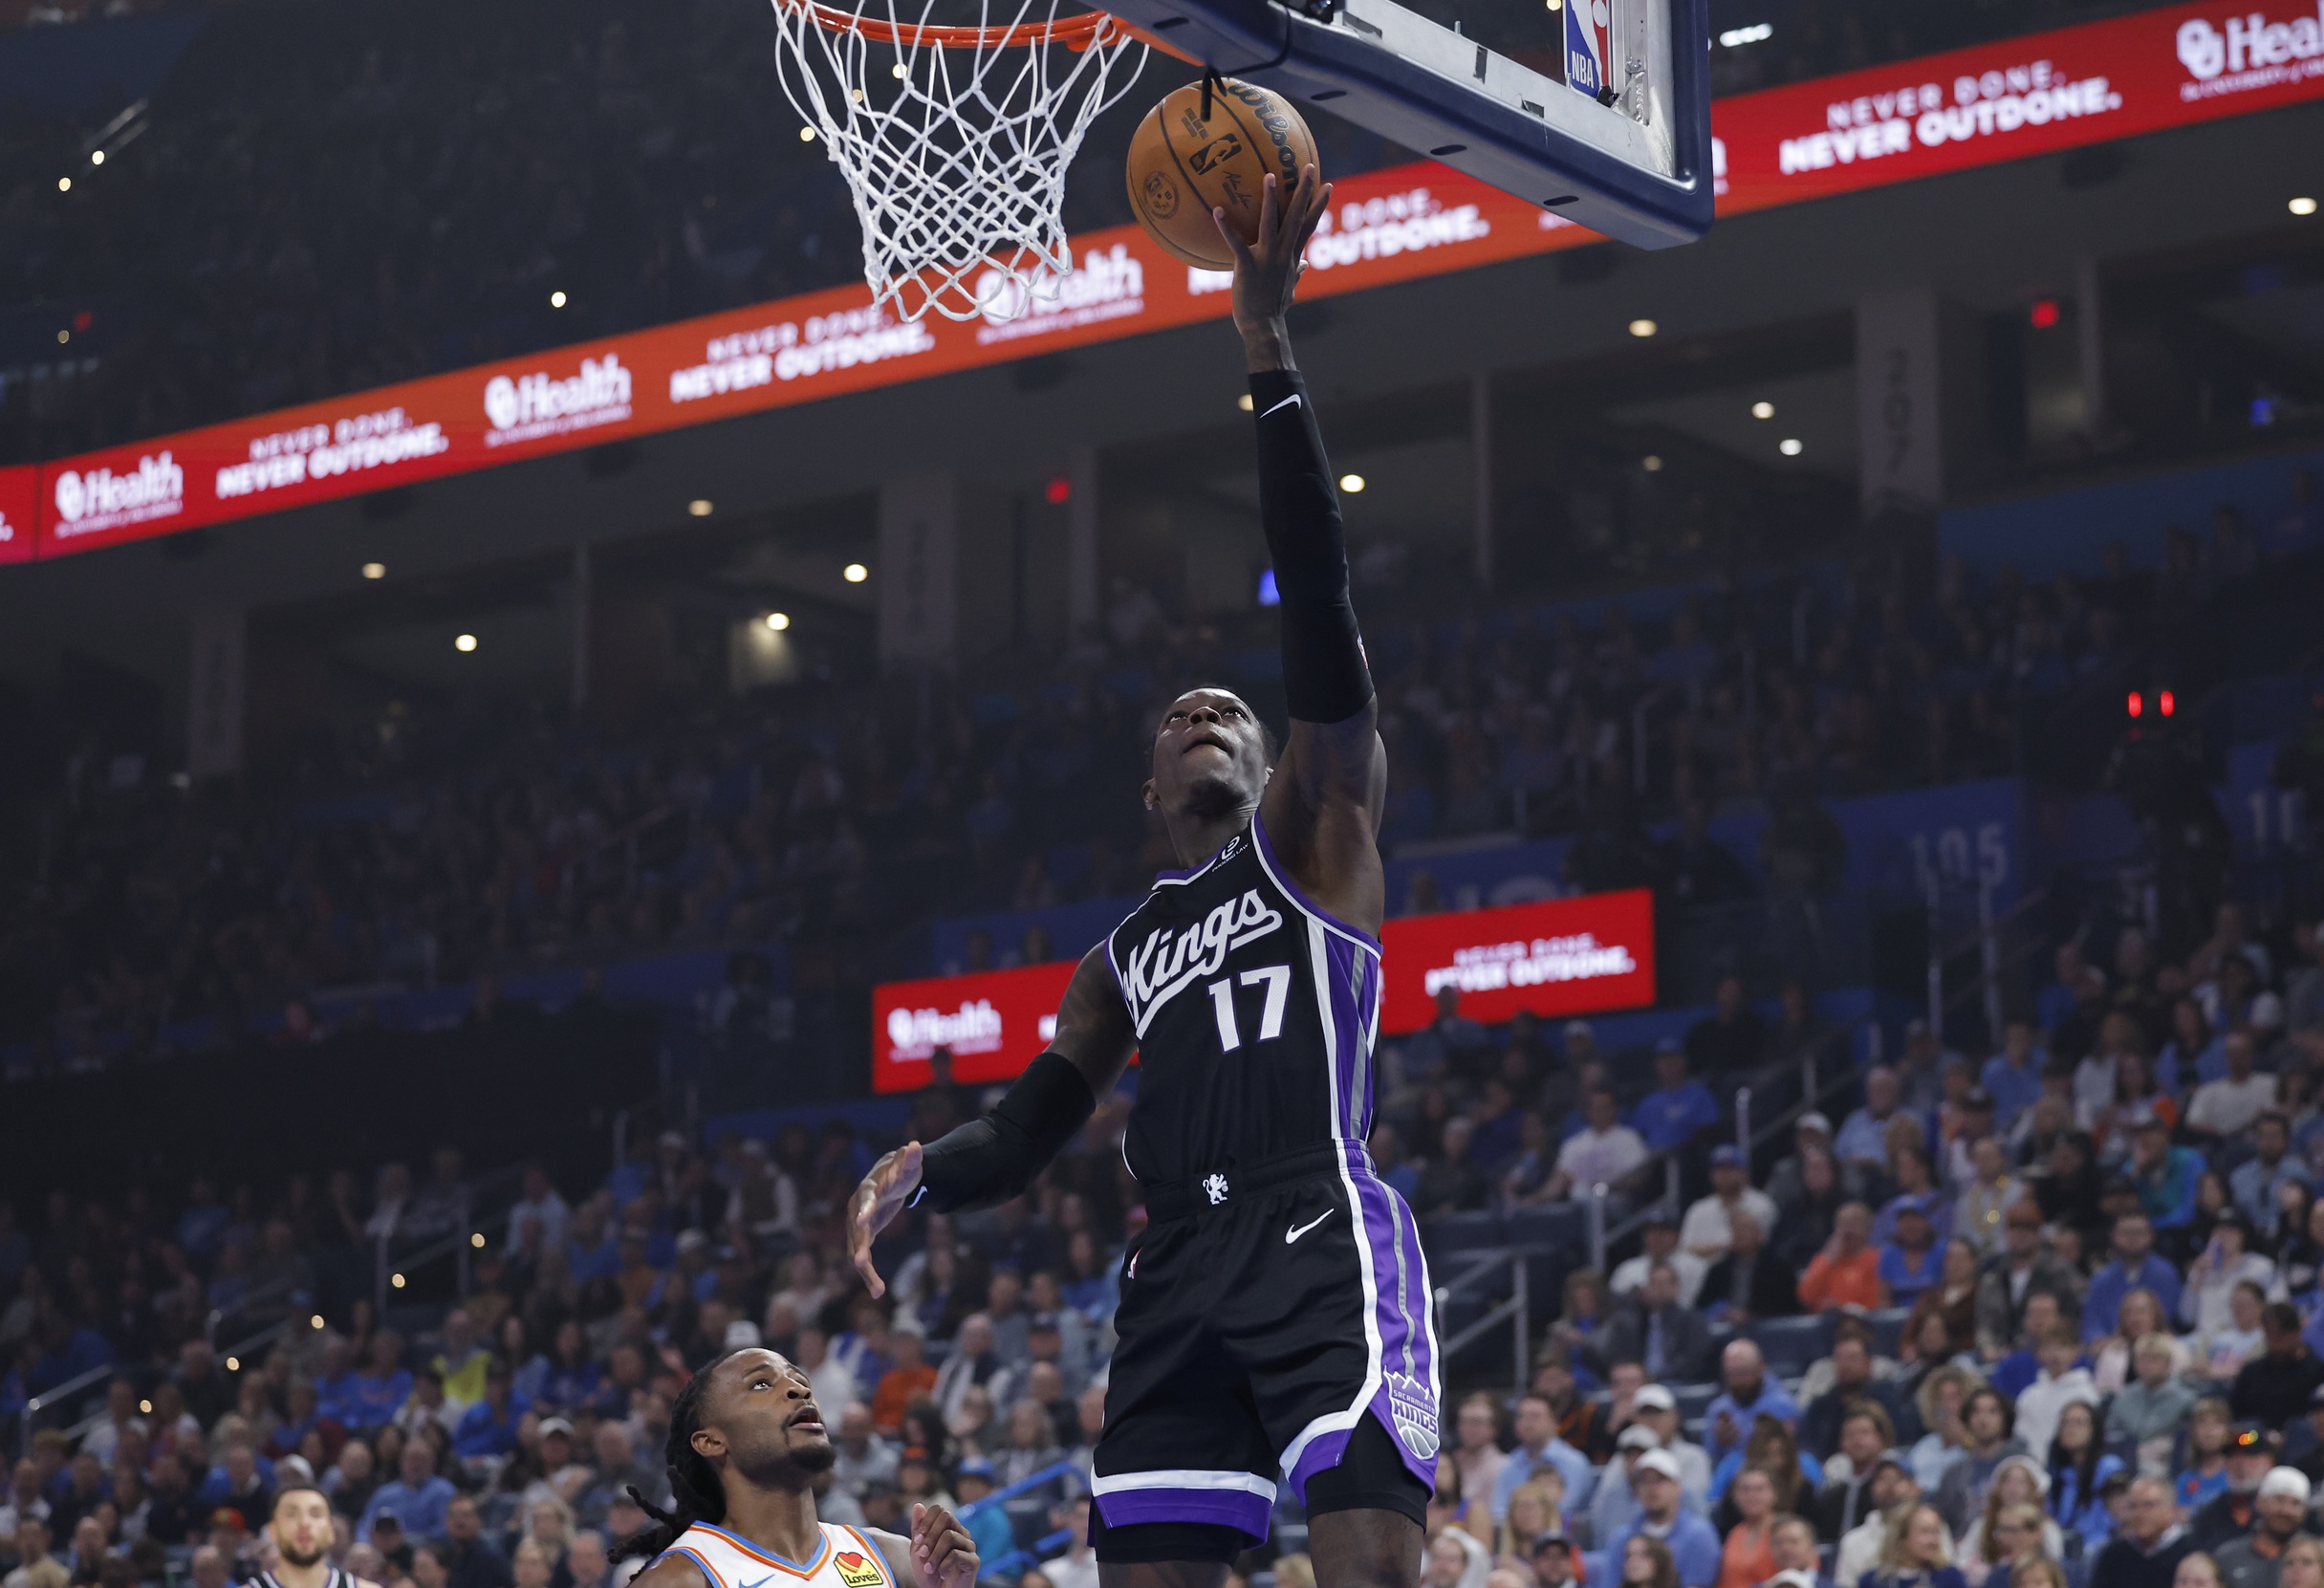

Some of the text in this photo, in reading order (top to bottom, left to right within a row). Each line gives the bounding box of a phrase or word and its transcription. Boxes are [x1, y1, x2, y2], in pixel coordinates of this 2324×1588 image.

[1571, 50, 1595, 89] NBA
[1826, 58, 2067, 130] NEVER DONE.
[1779, 118, 1911, 175] NEVER
[1916, 76, 2122, 146] OUTDONE.
[1306, 204, 1490, 270] OUTDONE.
[669, 353, 773, 402] NEVER
[774, 319, 936, 381] OUTDONE.
[707, 322, 798, 363] NEVER
[517, 353, 632, 424] Health
[216, 453, 306, 499] NEVER
[308, 422, 449, 479] OUTDONE.
[250, 424, 330, 462] NEVER
[84, 449, 184, 518] Health
[1123, 888, 1283, 1040] Kings
[1208, 965, 1291, 1053] 17
[1393, 1389, 1436, 1416] SACRAMENTO
[1394, 1399, 1438, 1436] KINGS
